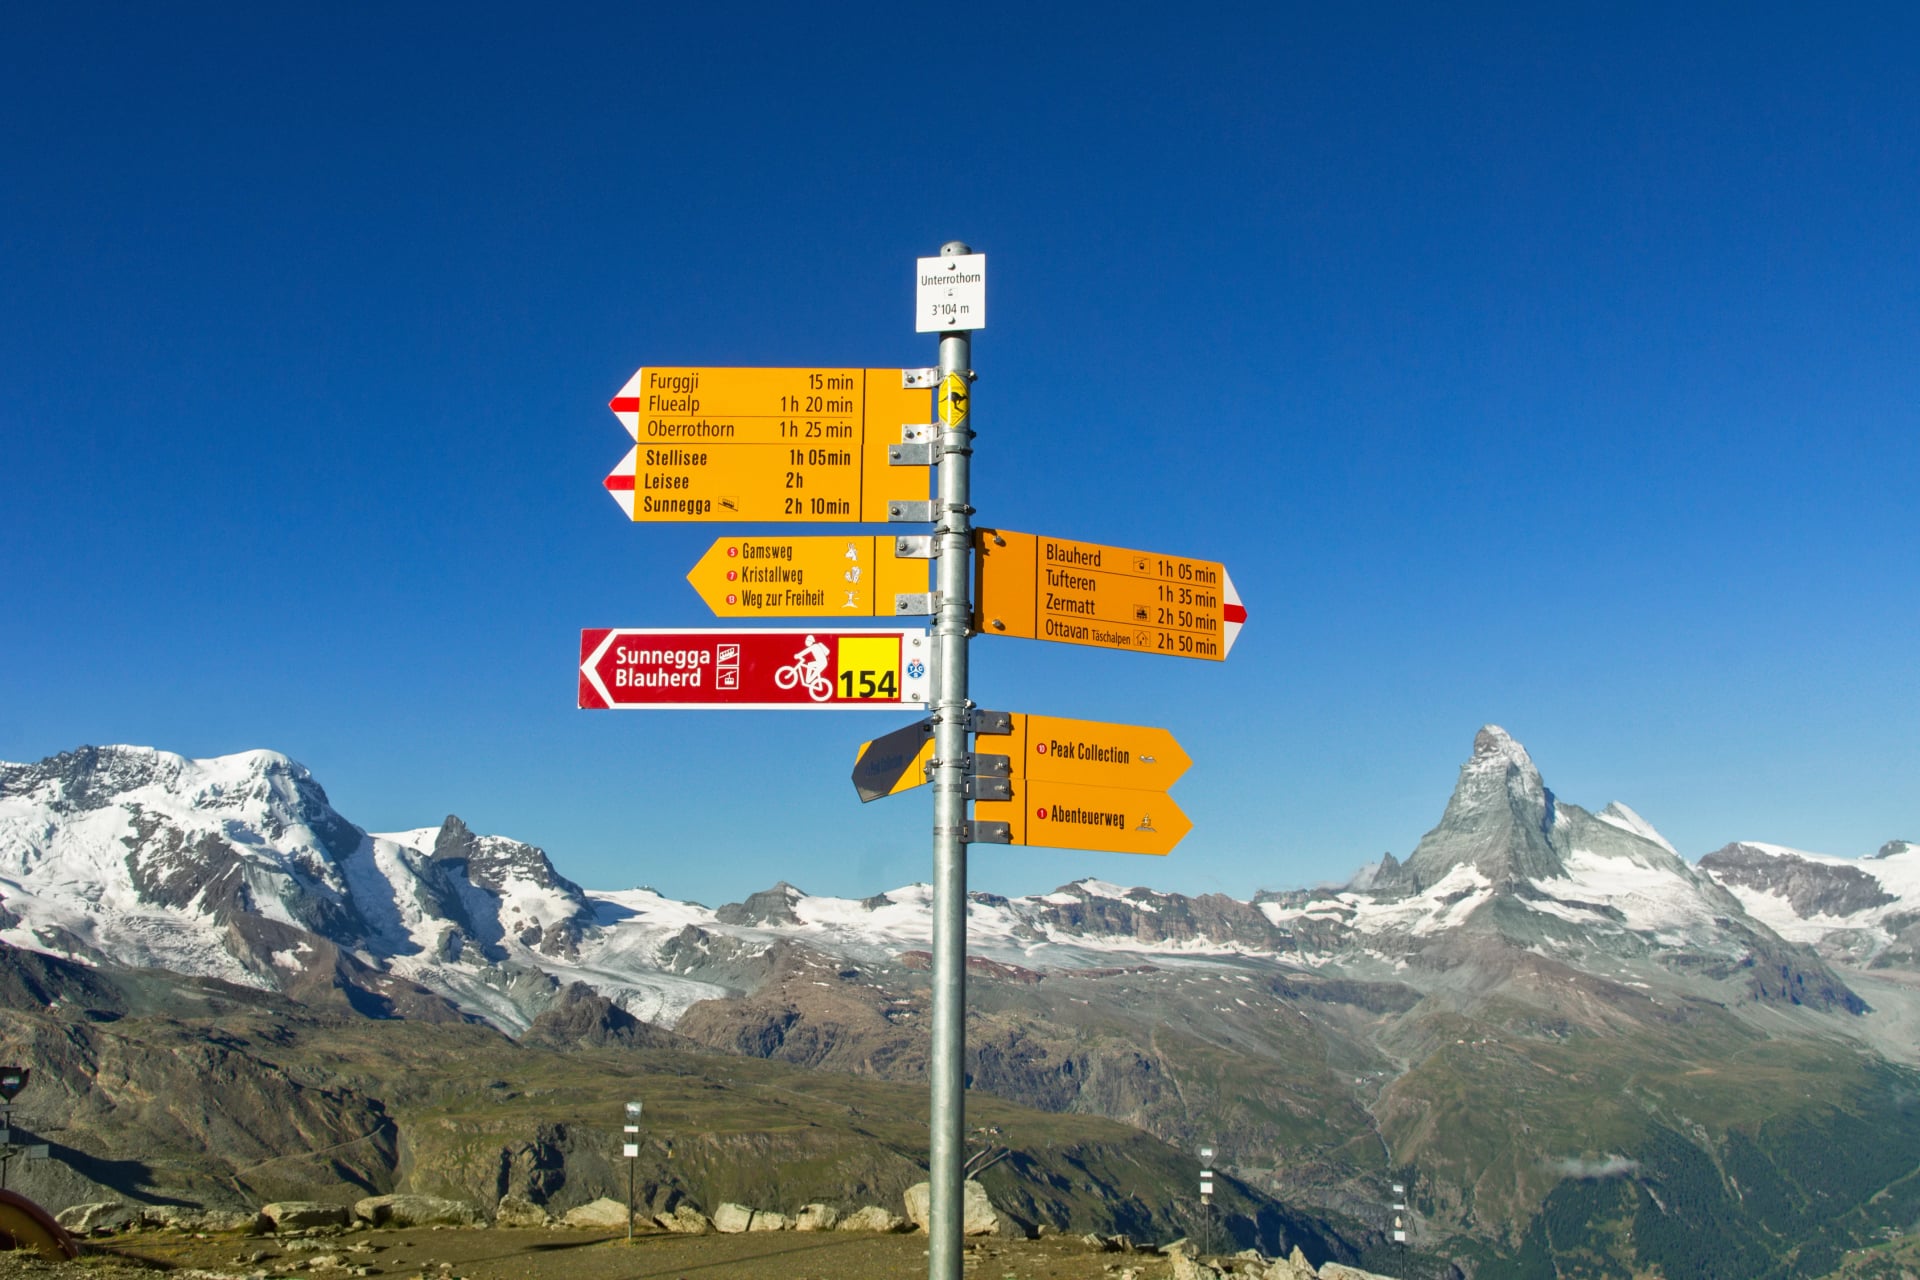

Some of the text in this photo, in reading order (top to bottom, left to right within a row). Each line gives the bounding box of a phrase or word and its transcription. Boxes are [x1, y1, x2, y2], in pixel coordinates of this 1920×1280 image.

[922, 272, 980, 286] Unterrothorn
[651, 373, 853, 393] Furggji 15 min
[648, 395, 700, 416] Fluealp
[806, 397, 822, 412] 20
[827, 396, 852, 412] min
[647, 422, 734, 438] Oberrothorn
[806, 422, 821, 437] 25
[826, 422, 852, 437] min
[647, 450, 707, 465] Stellisee
[645, 473, 688, 489] Leisee
[644, 496, 710, 515] Sunnegga
[743, 543, 792, 561] Gamsweg
[1047, 543, 1101, 568] Blauherd
[1179, 564, 1192, 580] 05
[1196, 567, 1216, 584] min
[742, 566, 802, 584] Kristallweg
[1046, 569, 1096, 592] Tufteren
[1179, 588, 1192, 605] 35
[1196, 592, 1216, 608] min
[742, 590, 762, 608] Weg
[766, 592, 782, 607] zur
[786, 590, 824, 606] Freiheit
[1046, 593, 1095, 617] Zermatt
[1179, 611, 1192, 627] 50
[1196, 614, 1216, 630] min
[1046, 619, 1089, 640] Ottavan
[1179, 636, 1192, 652] 50
[1196, 638, 1216, 655] min
[616, 646, 897, 698] Sunnegga 154
[616, 668, 702, 687] Blauherd
[1051, 740, 1074, 758] Peak
[1078, 743, 1129, 764] Collection
[1052, 805, 1124, 829] Abenteuerweg
